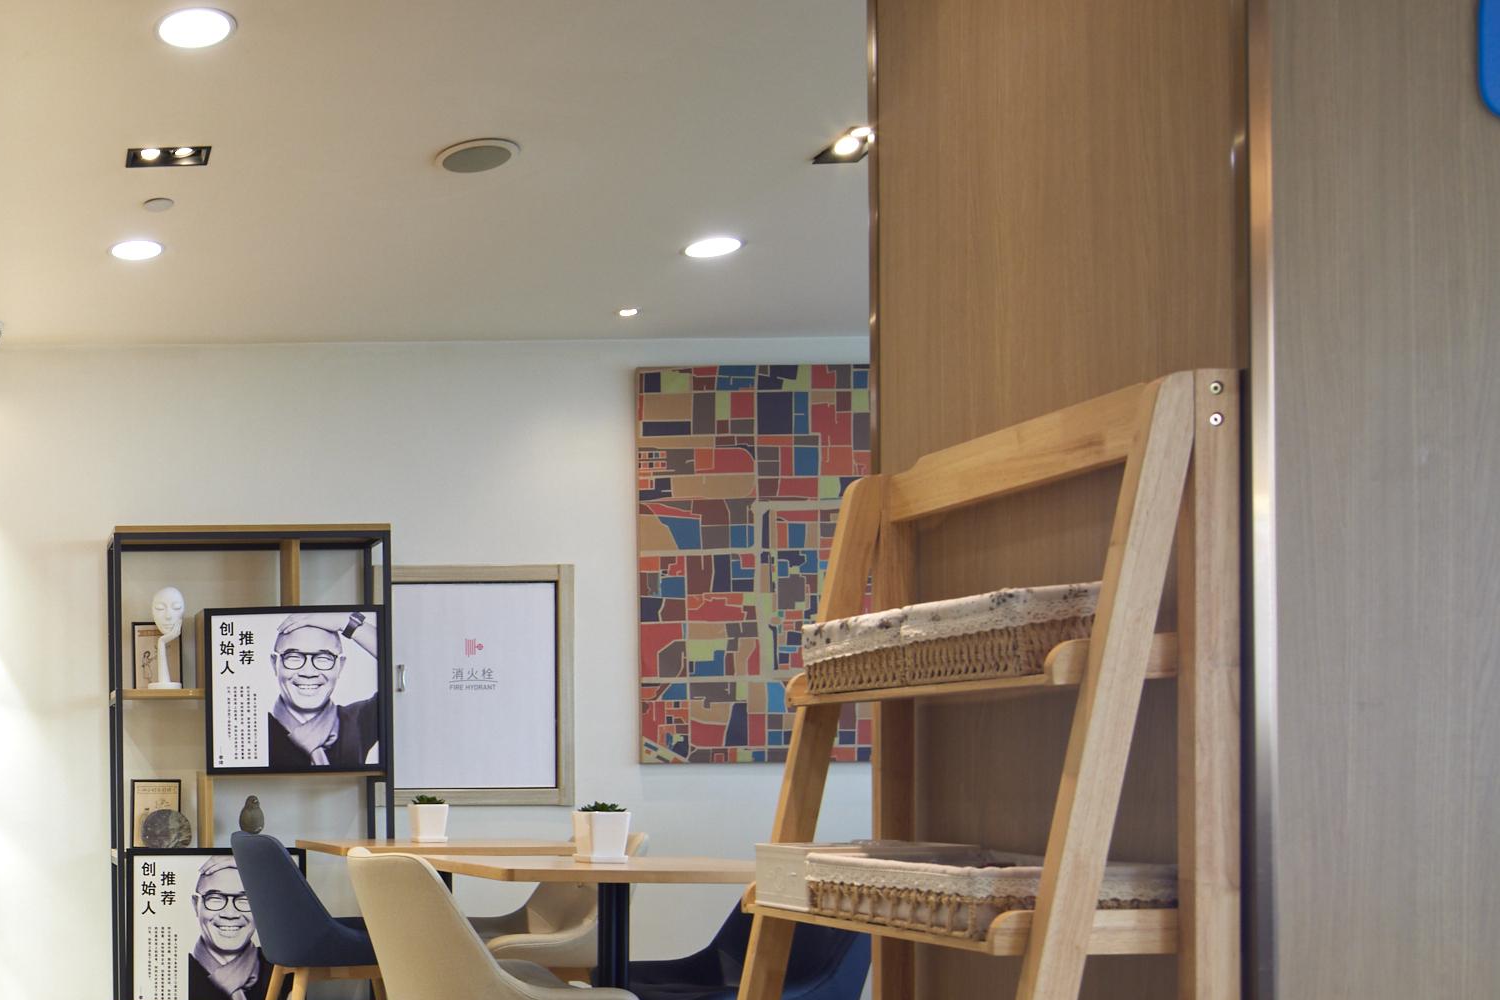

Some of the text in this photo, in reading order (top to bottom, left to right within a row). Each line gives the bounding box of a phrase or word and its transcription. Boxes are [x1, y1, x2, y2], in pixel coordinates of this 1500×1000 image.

[219, 621, 235, 675] 创始人
[238, 630, 255, 665] 推荐
[449, 683, 497, 691] FIRE HYDRANT
[451, 667, 494, 680] 消火栓
[141, 861, 157, 915] 创始人
[160, 871, 177, 906] 推荐
